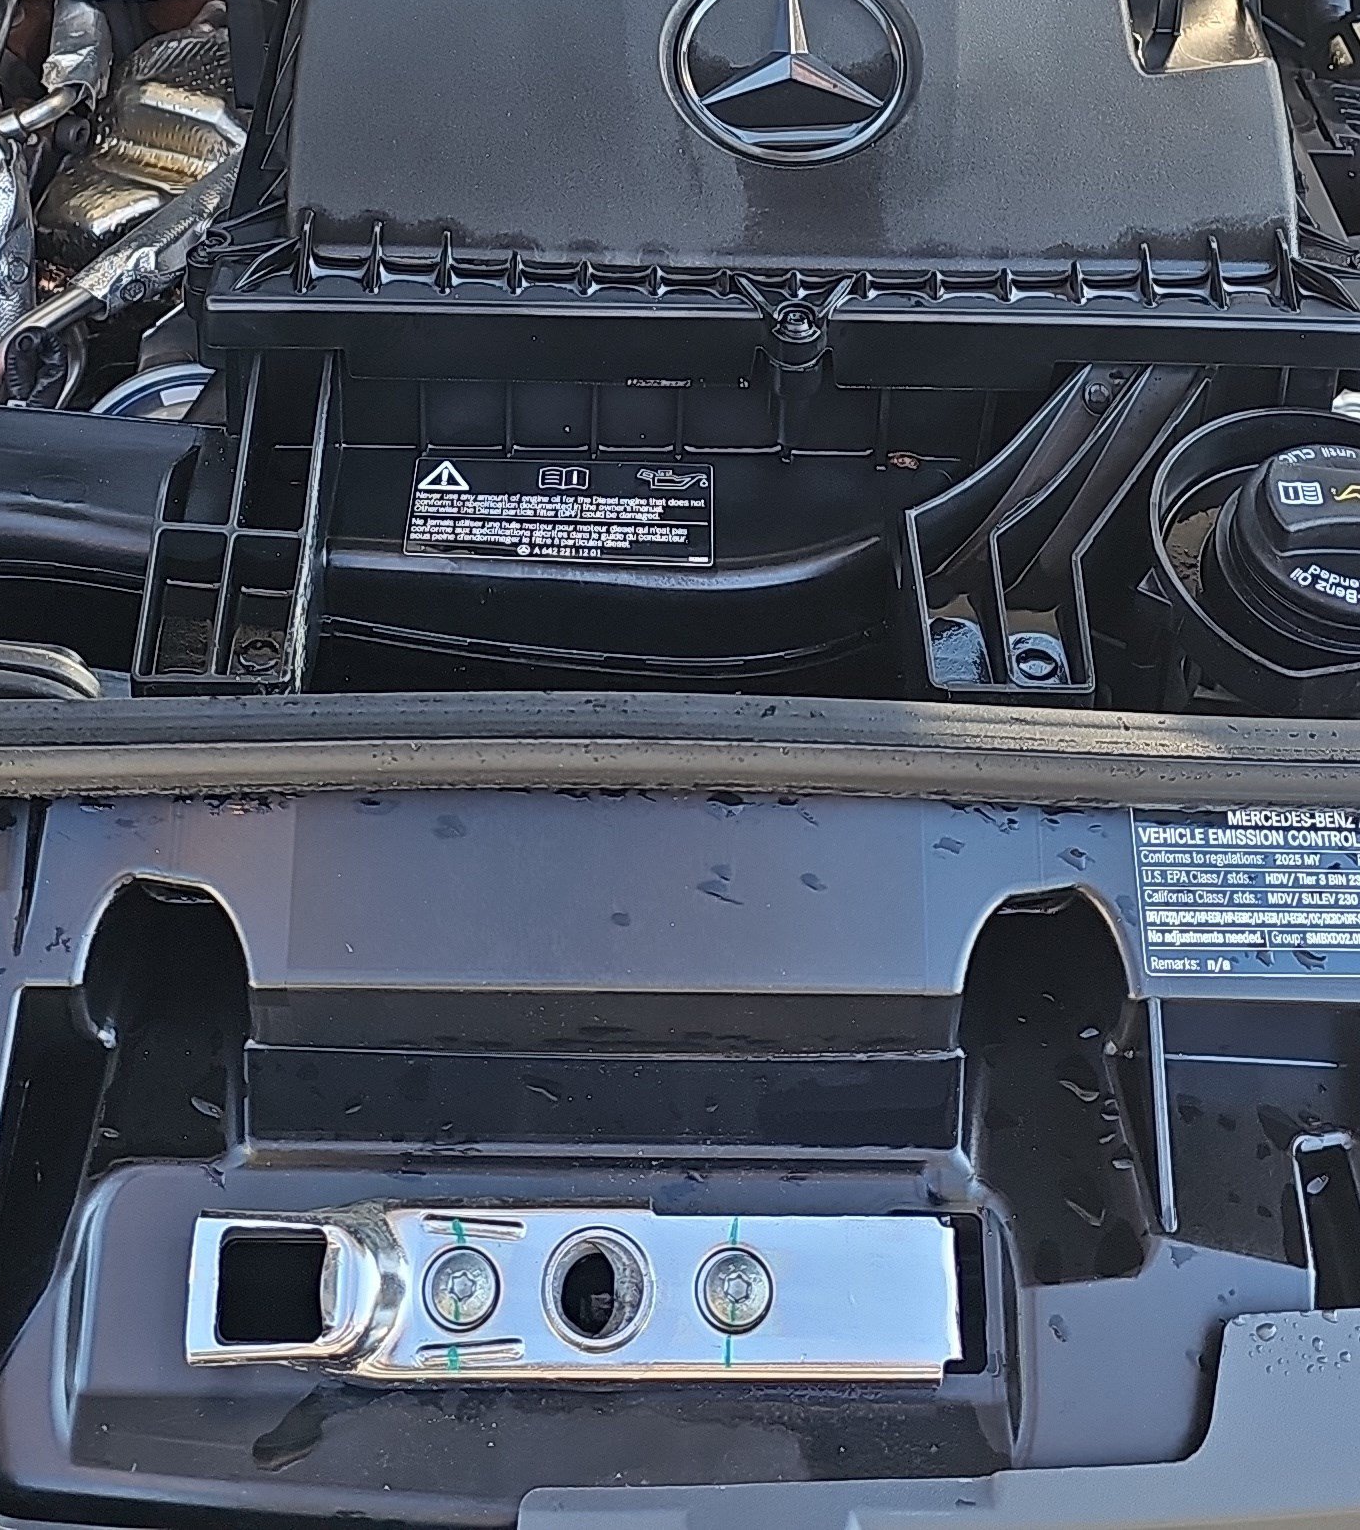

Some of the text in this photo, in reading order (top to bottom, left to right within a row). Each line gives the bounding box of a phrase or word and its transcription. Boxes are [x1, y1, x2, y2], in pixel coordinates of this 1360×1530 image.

[1290, 568, 1312, 586] Oil
[1227, 811, 1355, 828] MERCEDES-BENZ
[1139, 827, 1205, 844] VEHICLE
[1208, 828, 1284, 846] EMISSION
[1141, 851, 1191, 864] Conforms
[1193, 852, 1203, 864] to
[1275, 854, 1302, 865] 2025
[1304, 854, 1320, 866] MY
[1143, 870, 1164, 883] U.S.
[1167, 871, 1188, 883] EPA
[1190, 871, 1224, 885] Class/
[1266, 873, 1295, 886] HDV/
[1318, 874, 1326, 884] 3
[1328, 874, 1347, 885] BIN
[1144, 891, 1358, 906] California Class/ MDV/ SULEV 230
[1148, 930, 1265, 945] No adjustments needed.
[1151, 957, 1231, 972] Remarks: n/a
